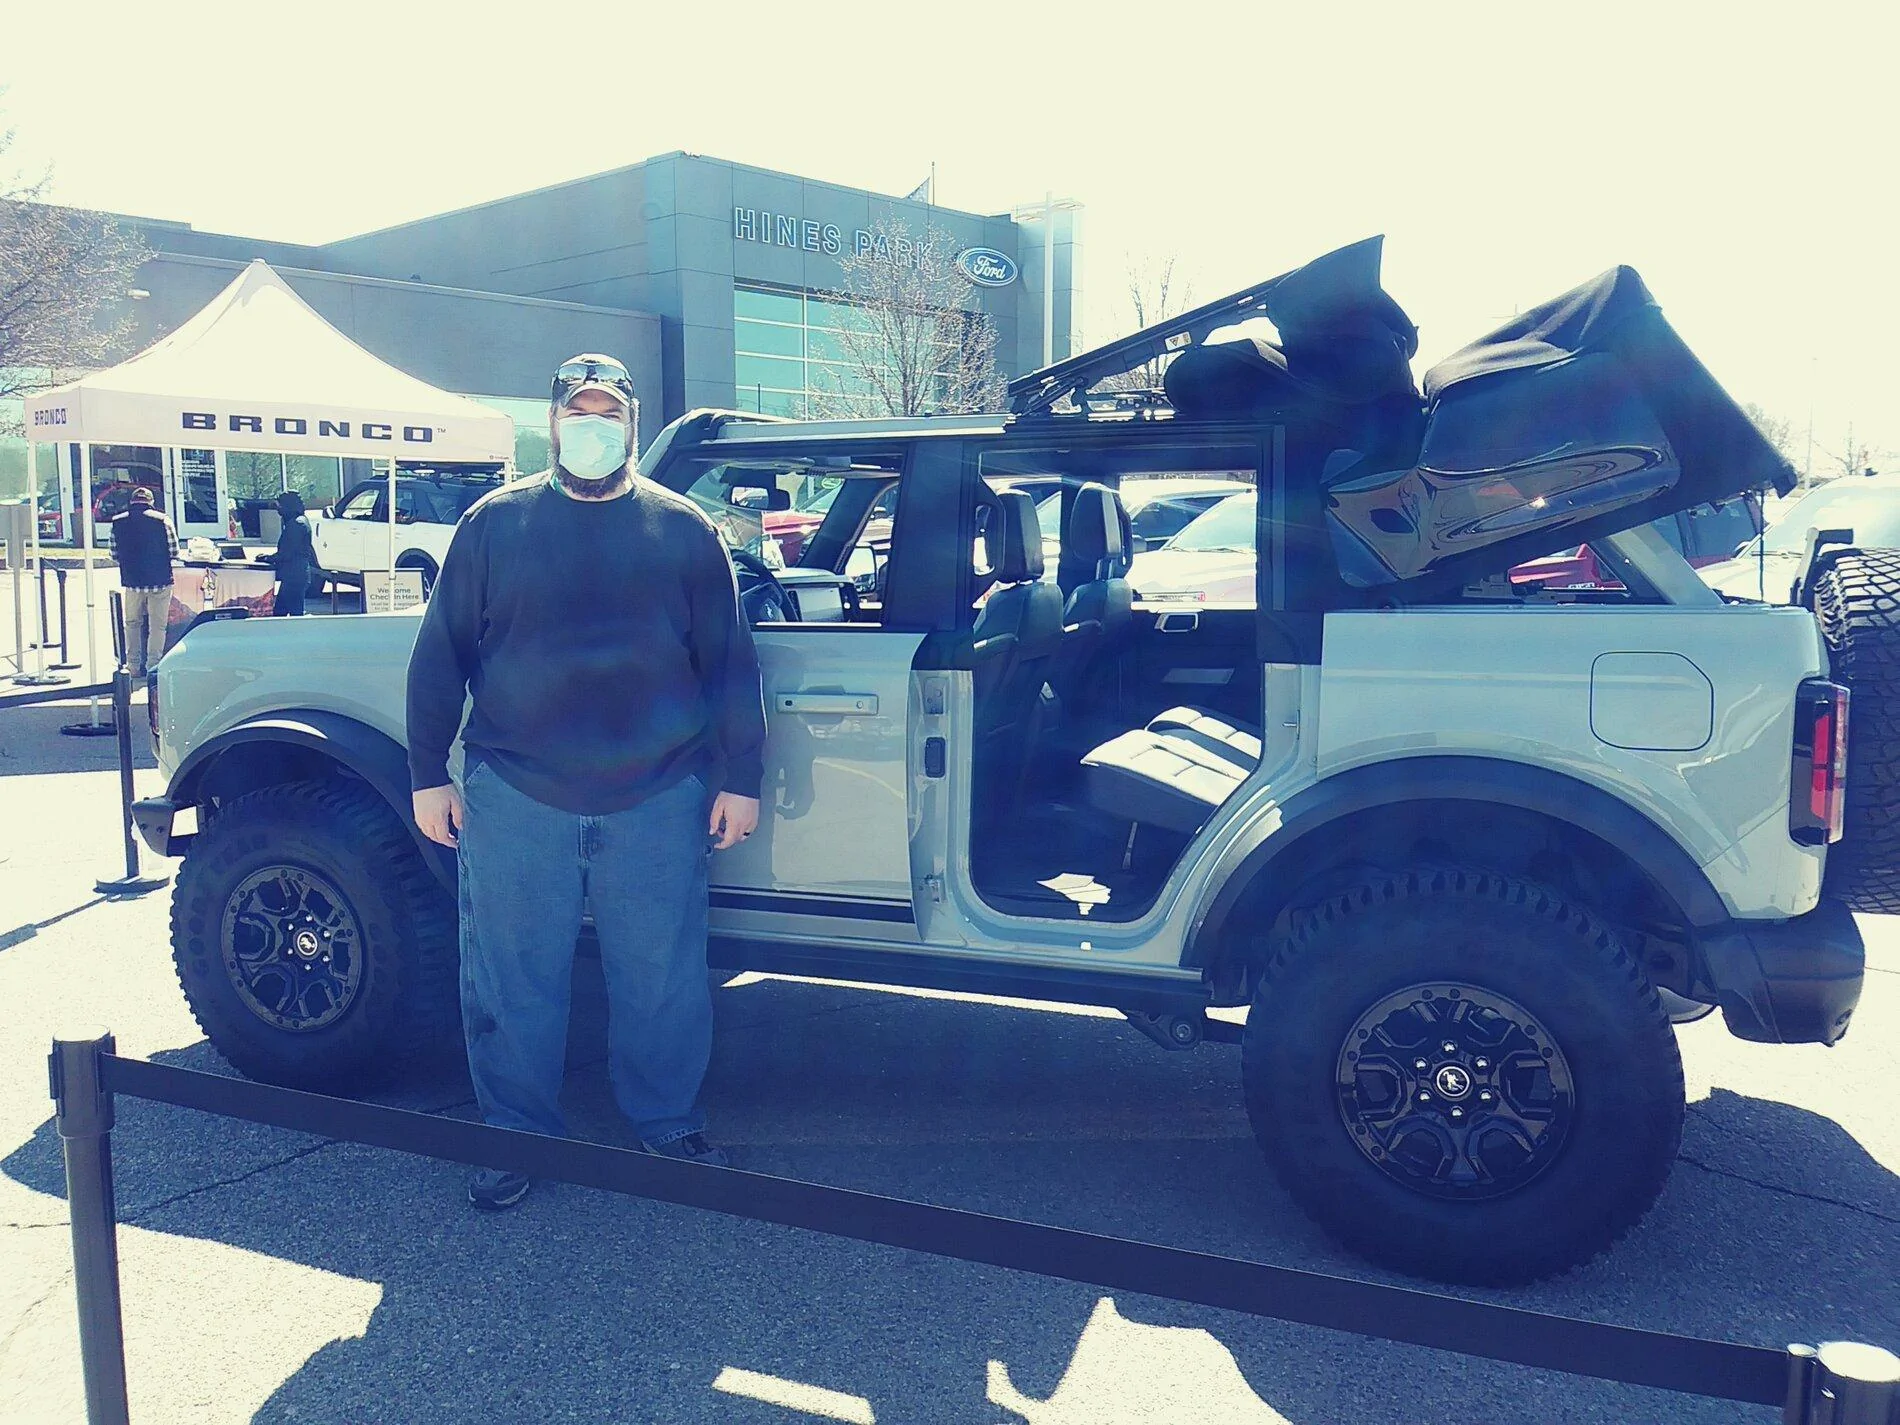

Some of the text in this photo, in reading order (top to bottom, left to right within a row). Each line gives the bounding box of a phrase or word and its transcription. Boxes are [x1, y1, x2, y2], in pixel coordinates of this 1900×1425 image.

[735, 207, 933, 270] HINES PARK
[973, 255, 1006, 279] Ford
[34, 408, 67, 426] BRONCO
[182, 412, 433, 443] BRONCO
